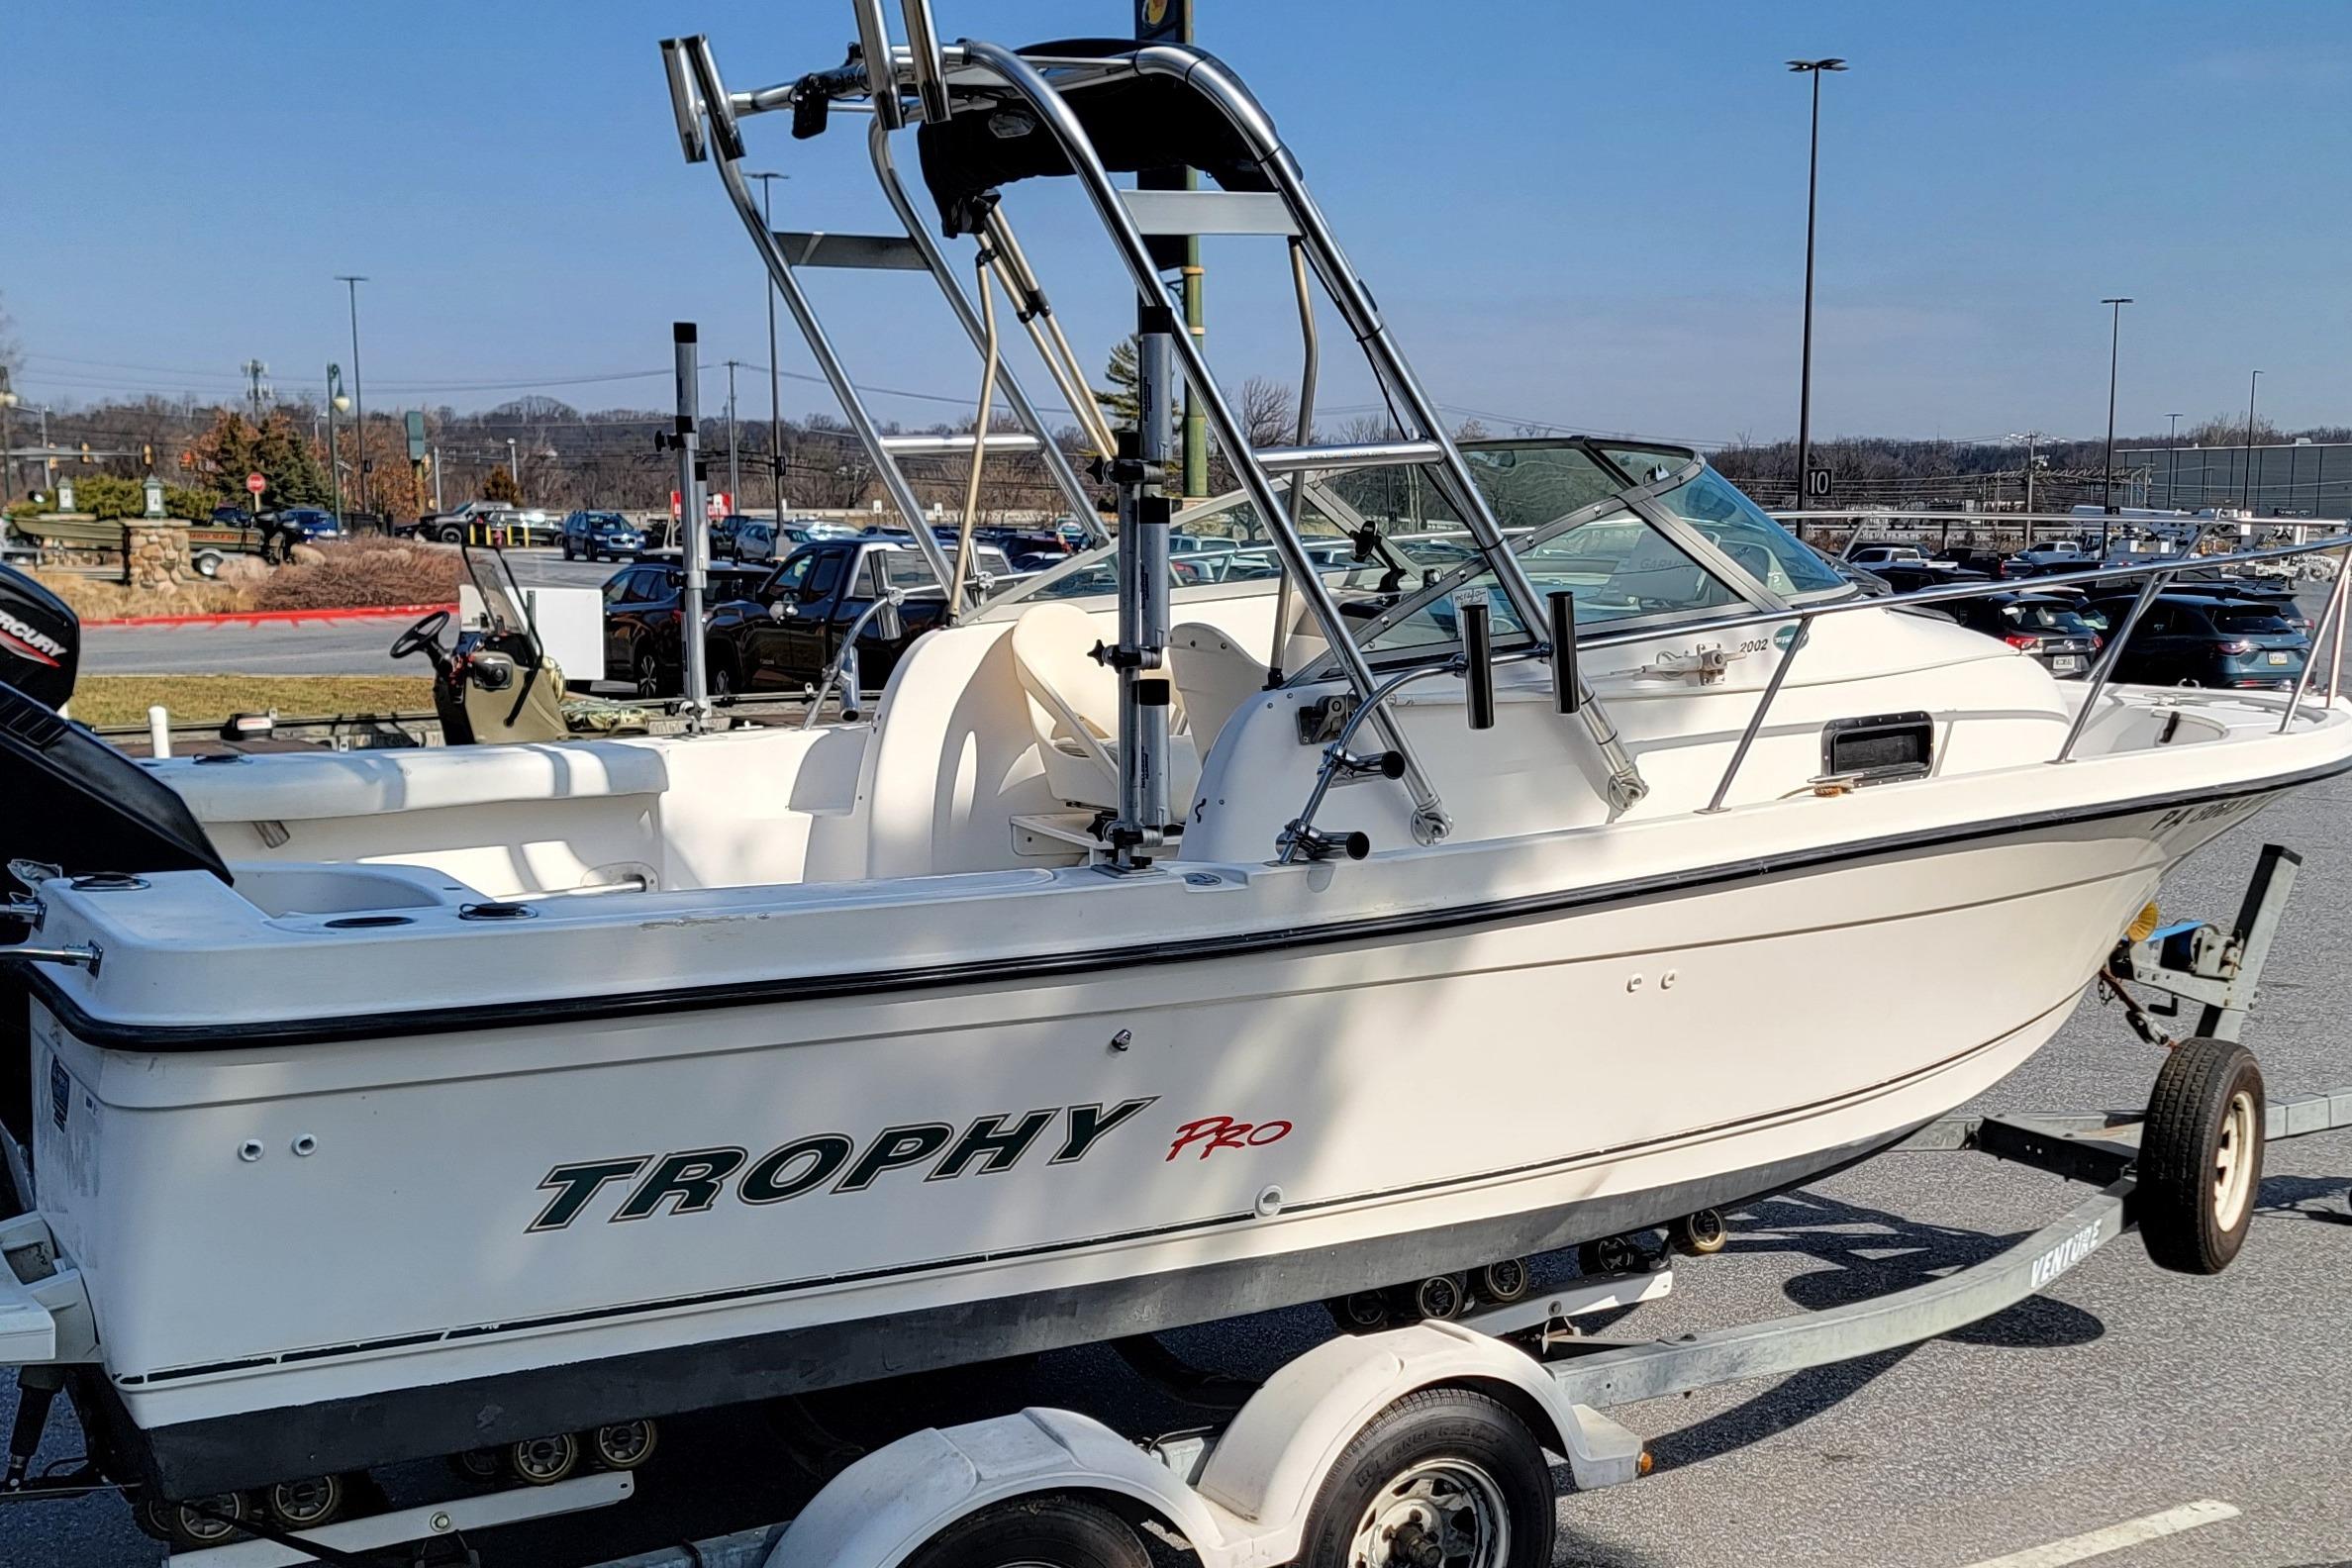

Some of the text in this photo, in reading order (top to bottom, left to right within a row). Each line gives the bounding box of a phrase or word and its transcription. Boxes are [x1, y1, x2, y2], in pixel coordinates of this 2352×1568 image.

[1810, 470, 1829, 495] 10
[0, 610, 68, 657] RCURY
[1739, 638, 1768, 653] 2002
[2149, 808, 2195, 832] PA
[525, 1095, 1293, 1233] TROPHY PRO
[2030, 1218, 2104, 1289] VENTURE
